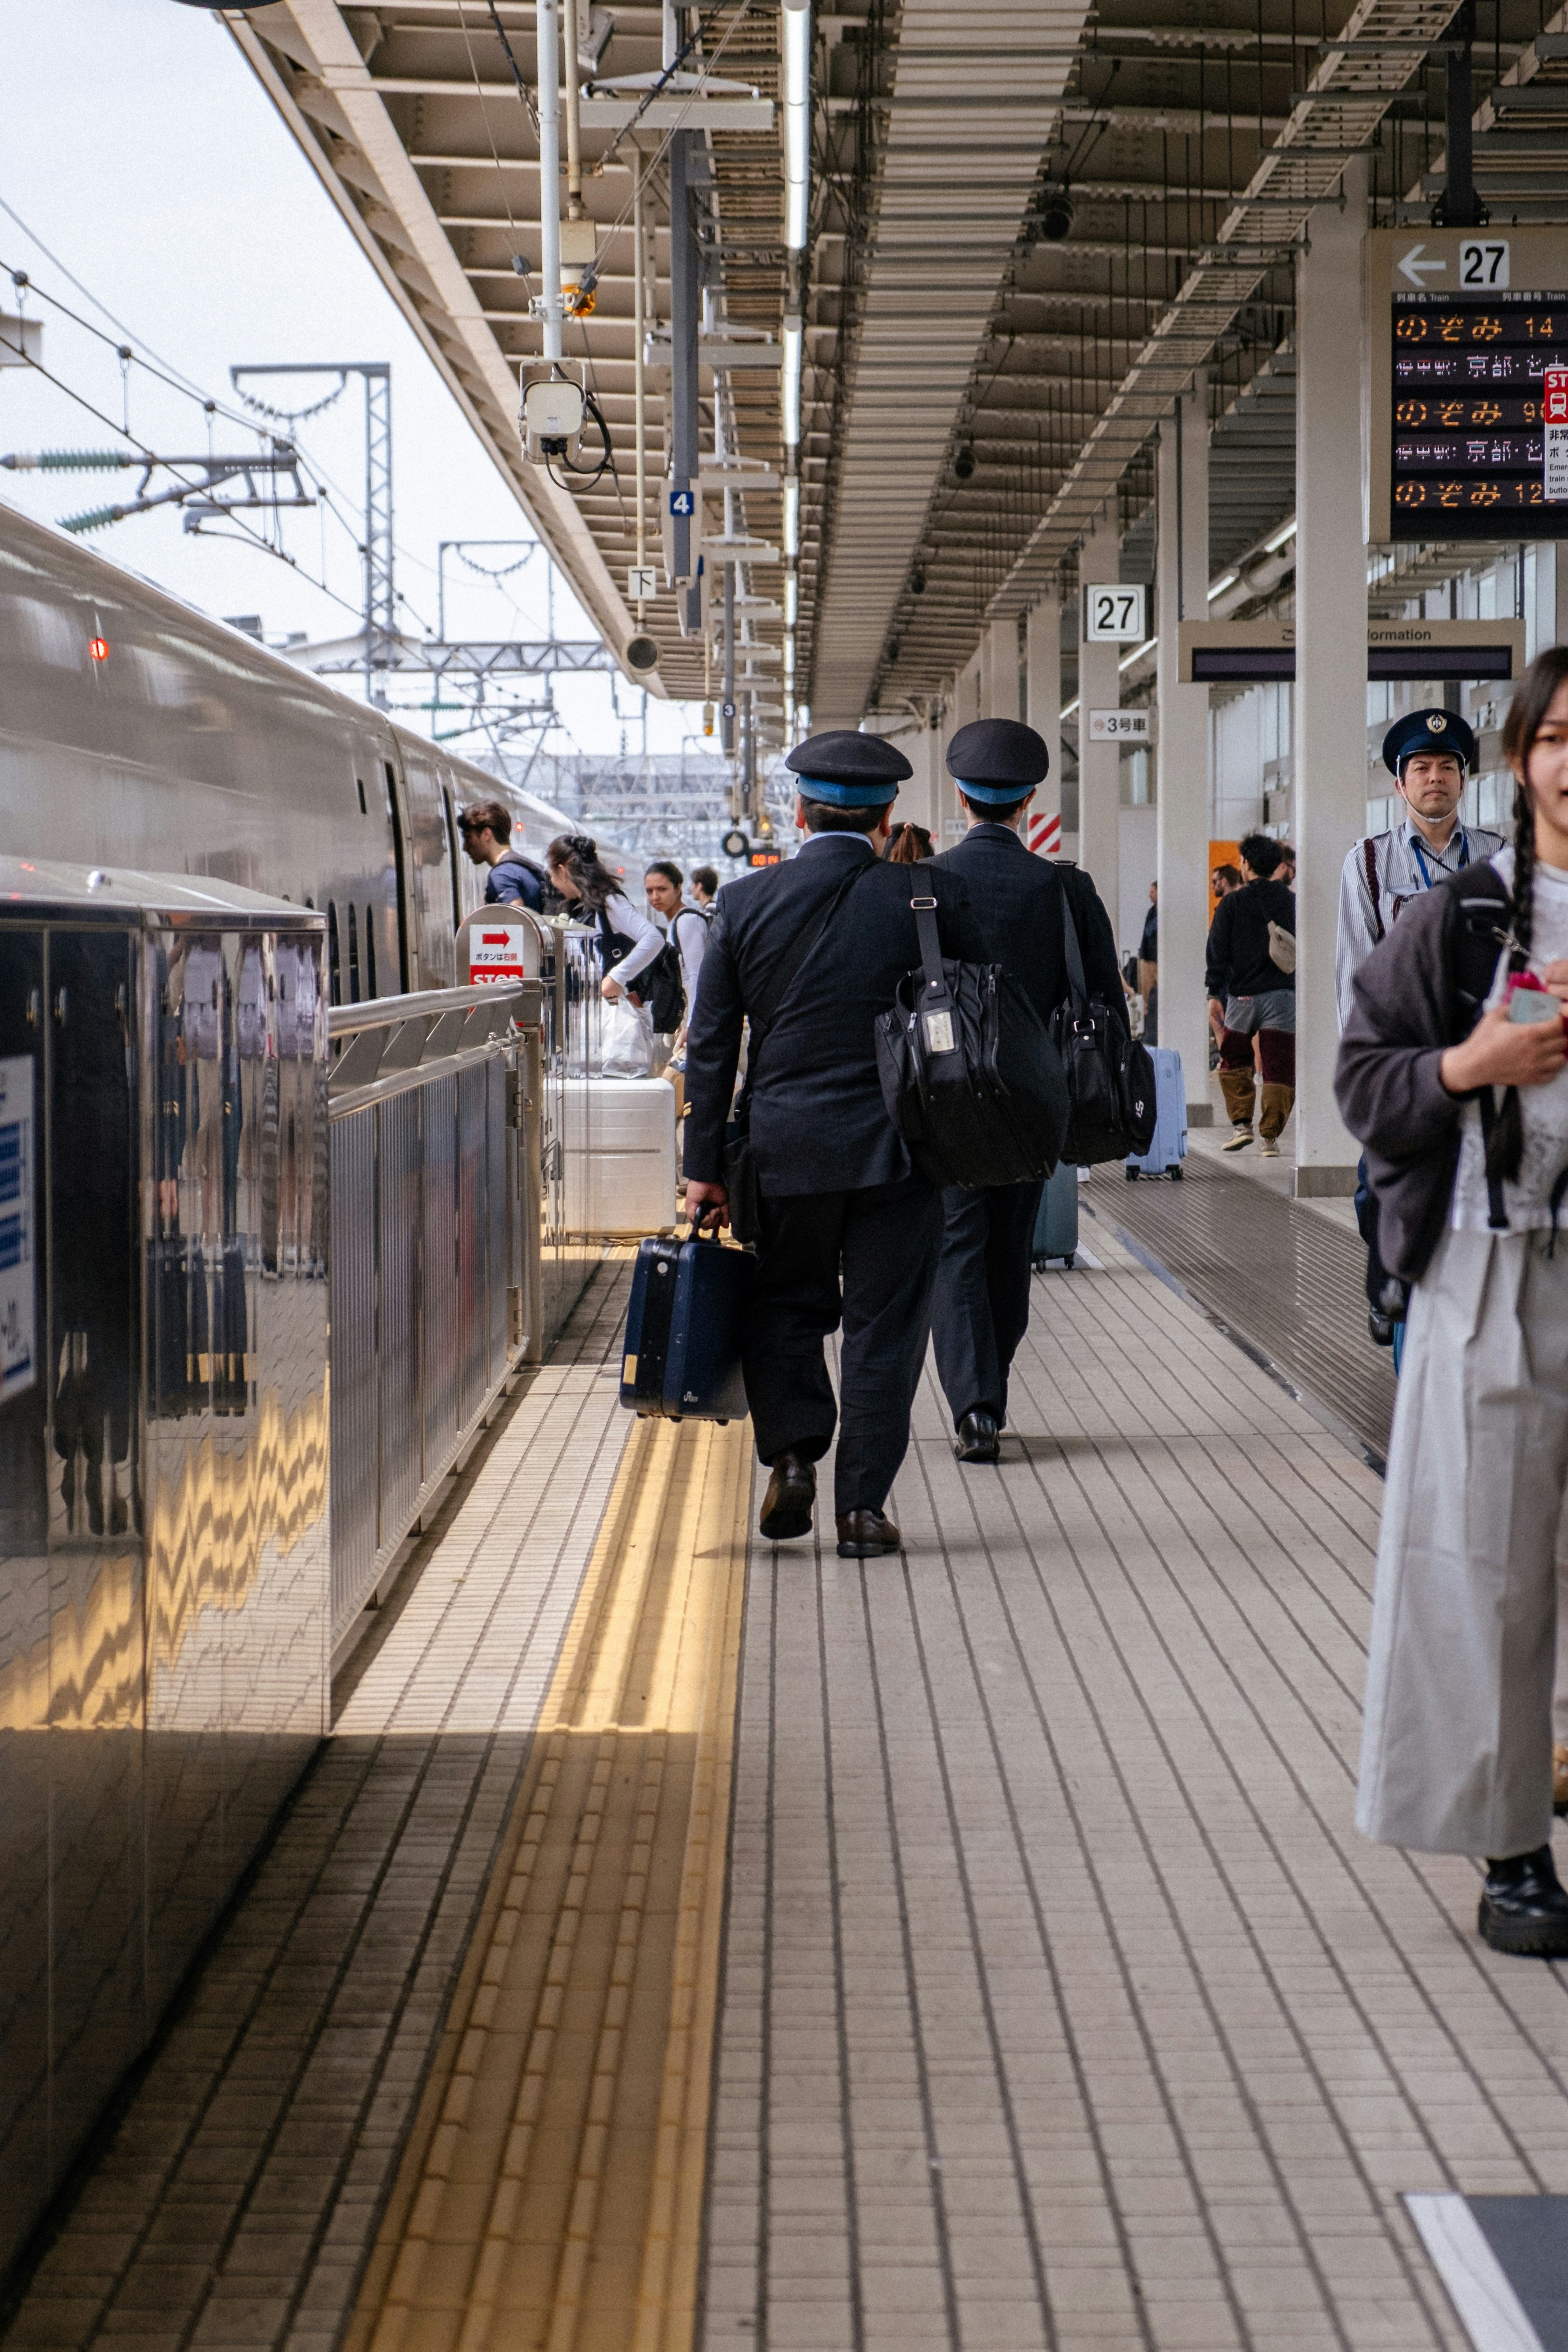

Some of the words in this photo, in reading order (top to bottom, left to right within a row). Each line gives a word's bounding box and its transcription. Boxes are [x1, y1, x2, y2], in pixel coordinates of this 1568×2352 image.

[1464, 246, 1505, 283] 27
[1429, 293, 1449, 302] Train
[1546, 291, 1565, 301] Train
[1397, 314, 1502, 341] のぞみ
[1526, 316, 1553, 338] 14
[1397, 400, 1502, 426] のぞみ
[673, 493, 690, 514] 4
[1395, 480, 1501, 506] のぞみ
[1098, 595, 1134, 629] 27
[724, 703, 734, 716] 3
[1107, 717, 1146, 732] 3号車
[475, 953, 517, 961] ボタンは右側
